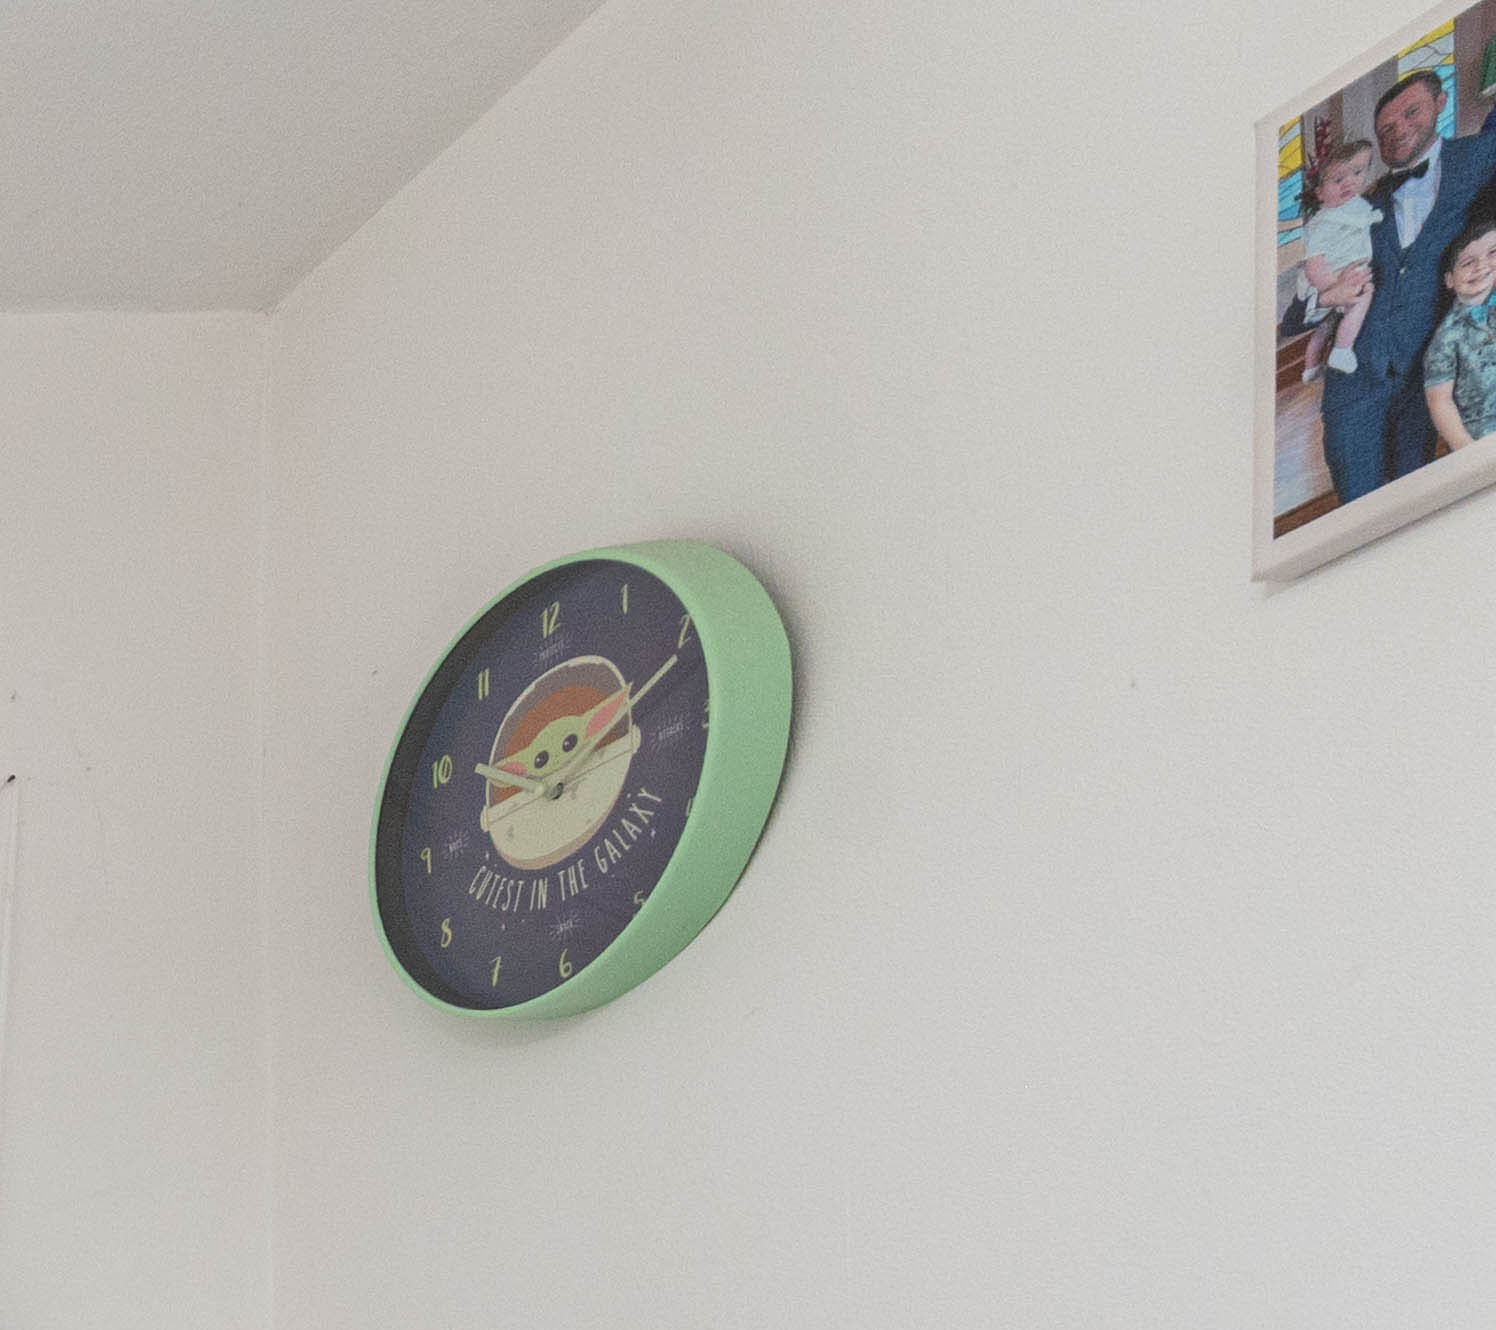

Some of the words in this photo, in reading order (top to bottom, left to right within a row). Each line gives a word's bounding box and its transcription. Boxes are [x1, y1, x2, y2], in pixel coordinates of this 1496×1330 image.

[540, 600, 561, 639] 12
[678, 613, 692, 649] 2
[478, 668, 490, 701] 11
[432, 754, 453, 789] 10
[419, 847, 433, 874] 9
[468, 865, 525, 913] CUTEST
[529, 877, 549, 911] IN
[557, 858, 590, 901] THE
[594, 787, 662, 875] GALAXY
[440, 917, 453, 948] 8
[490, 955, 503, 987] 7
[558, 948, 573, 979] 6
